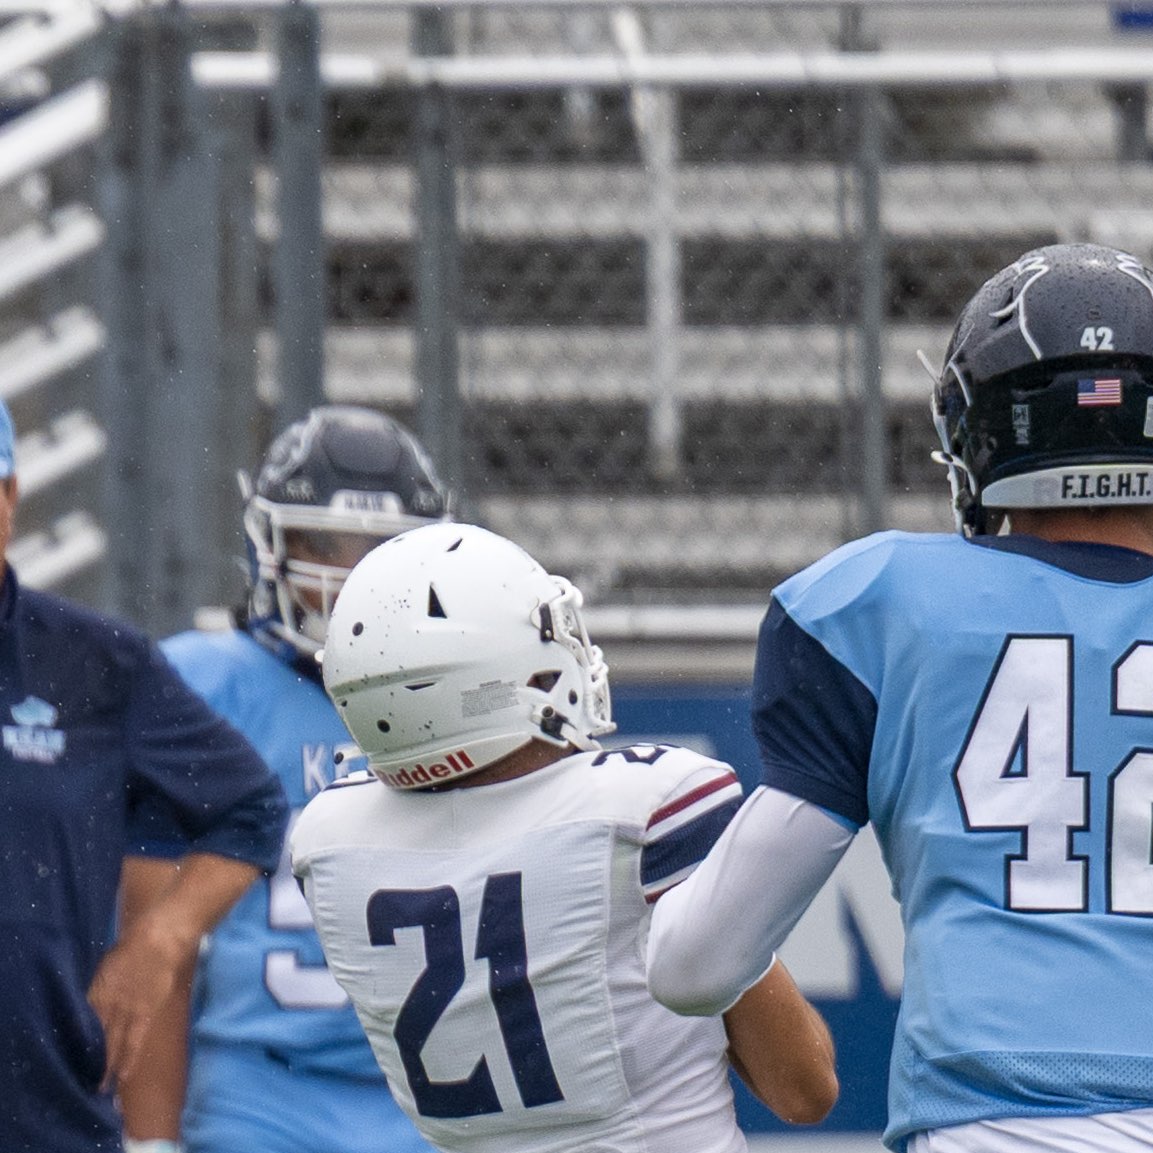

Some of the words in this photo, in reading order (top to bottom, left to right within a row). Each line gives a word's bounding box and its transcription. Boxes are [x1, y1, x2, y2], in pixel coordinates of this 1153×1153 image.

[1080, 326, 1113, 351] 42
[1061, 472, 1152, 499] F.I.G.H.T.
[366, 871, 565, 1119] 21
